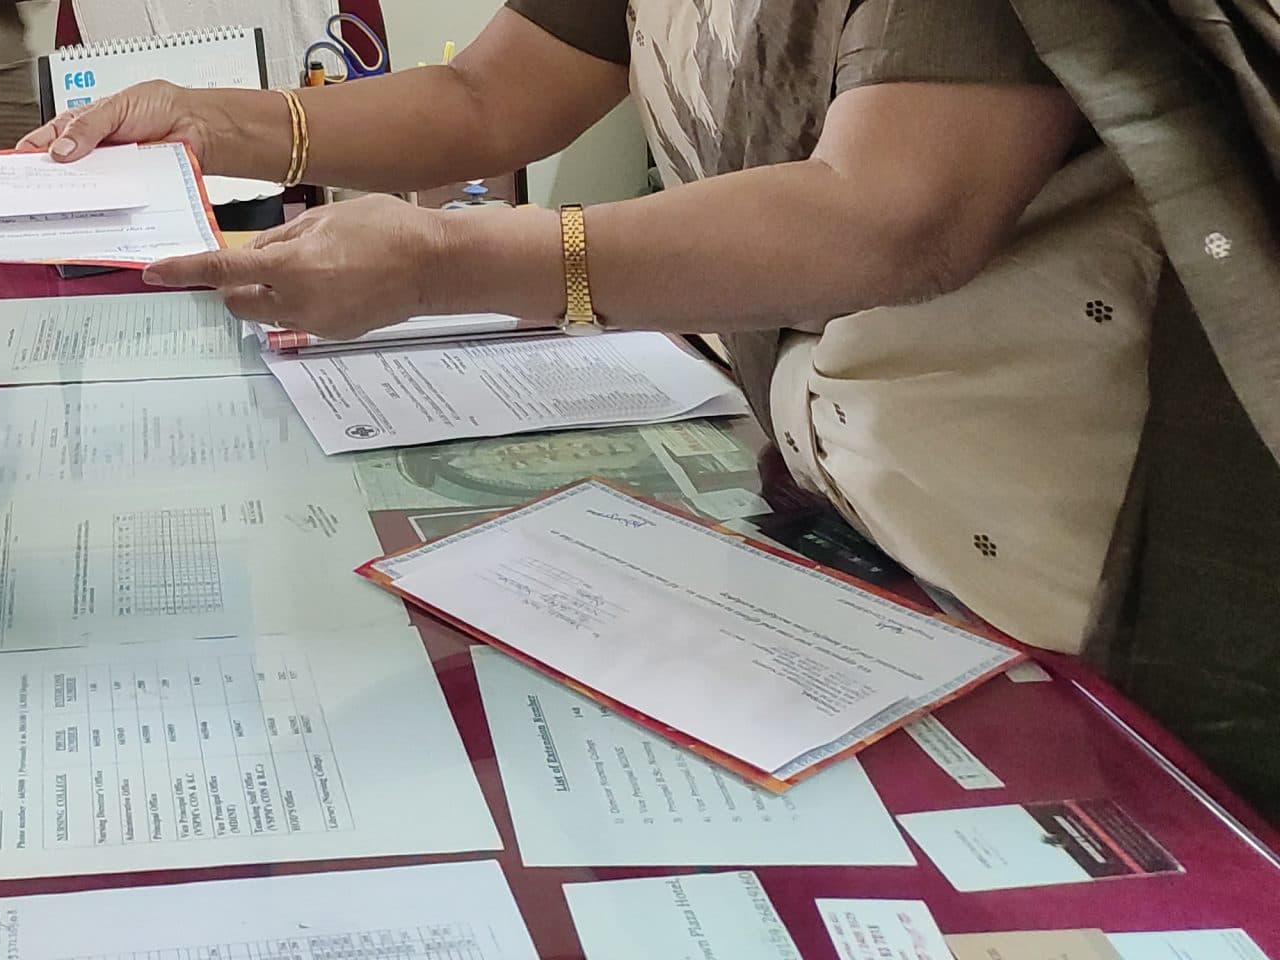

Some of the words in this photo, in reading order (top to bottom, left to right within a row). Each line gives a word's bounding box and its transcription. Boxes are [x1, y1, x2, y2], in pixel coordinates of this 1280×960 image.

[64, 70, 96, 90] FEB
[528, 695, 543, 722] Number
[538, 725, 556, 763] Extension
[548, 765, 560, 773] of
[56, 774, 67, 807] COLLEGE
[554, 776, 566, 791] List
[16, 830, 25, 848] Phone
[664, 878, 691, 908] Hotel,
[682, 909, 705, 938] Plaza
